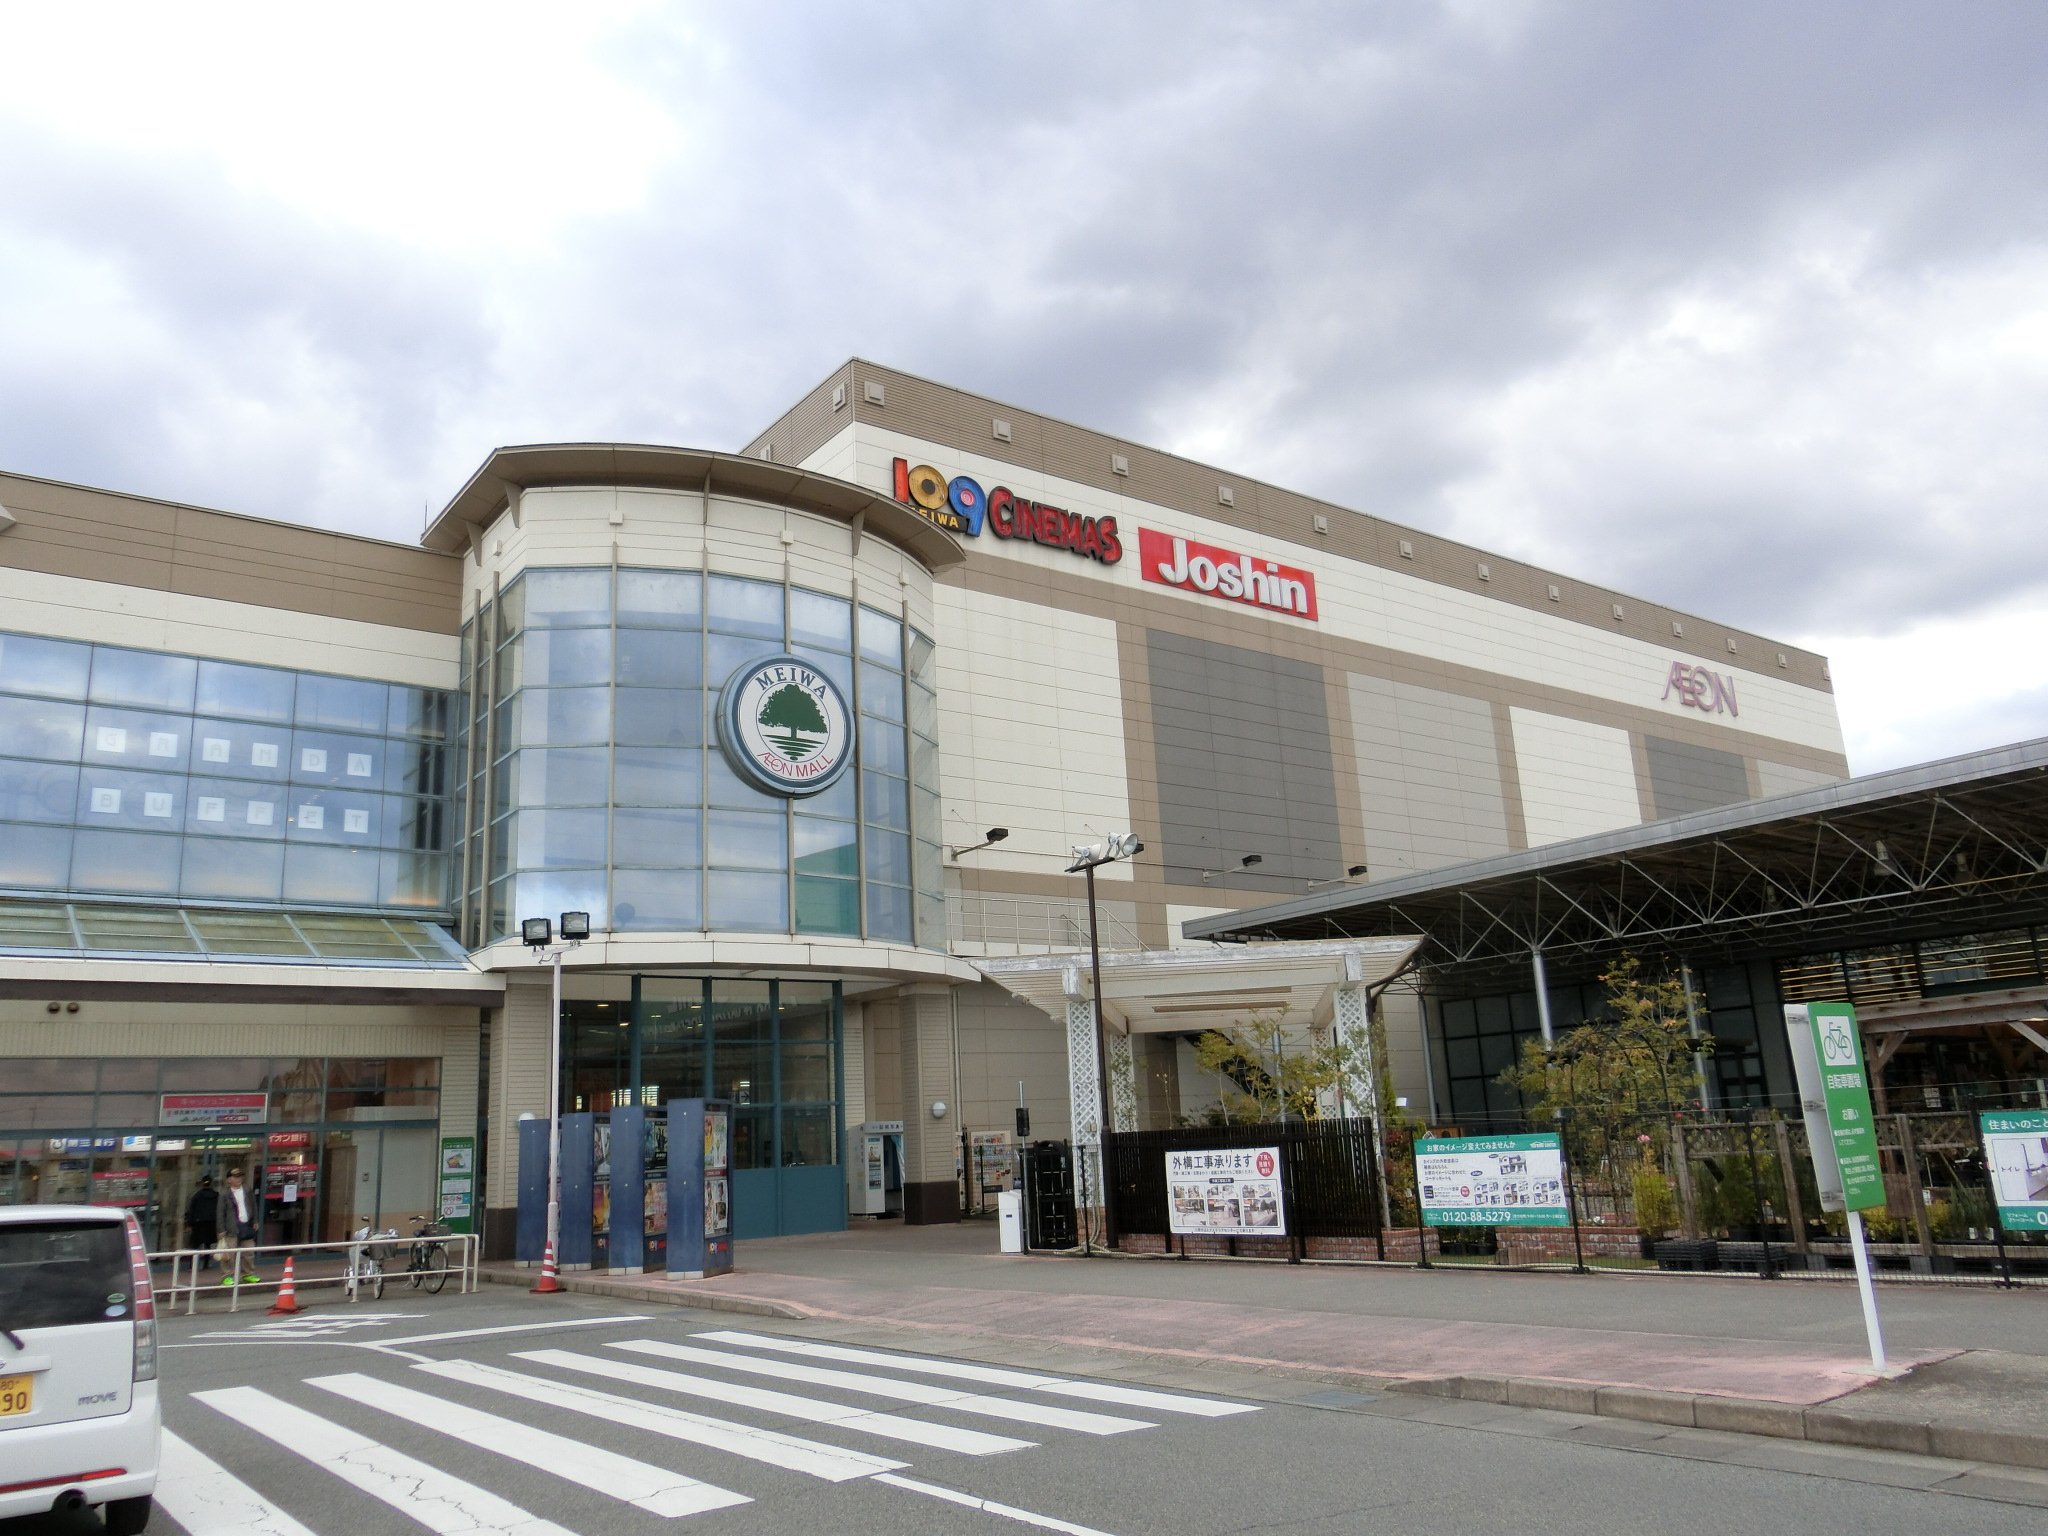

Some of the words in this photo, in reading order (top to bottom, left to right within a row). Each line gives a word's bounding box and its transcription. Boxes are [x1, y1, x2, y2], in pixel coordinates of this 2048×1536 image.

[893, 457, 986, 537] 109
[988, 486, 1123, 566] CINEMAS
[909, 507, 959, 528] EIWA
[1158, 538, 1308, 614] Joshin
[755, 667, 827, 699] MEIWA
[796, 755, 834, 777] MALL
[98, 792, 366, 830] BUFFET
[268, 1134, 307, 1142] イオン銀行
[1172, 1154, 1253, 1170] 外構工事承ります
[1442, 1211, 1511, 1222] 0120-88-5279
[78, 1391, 118, 1405] MOVE
